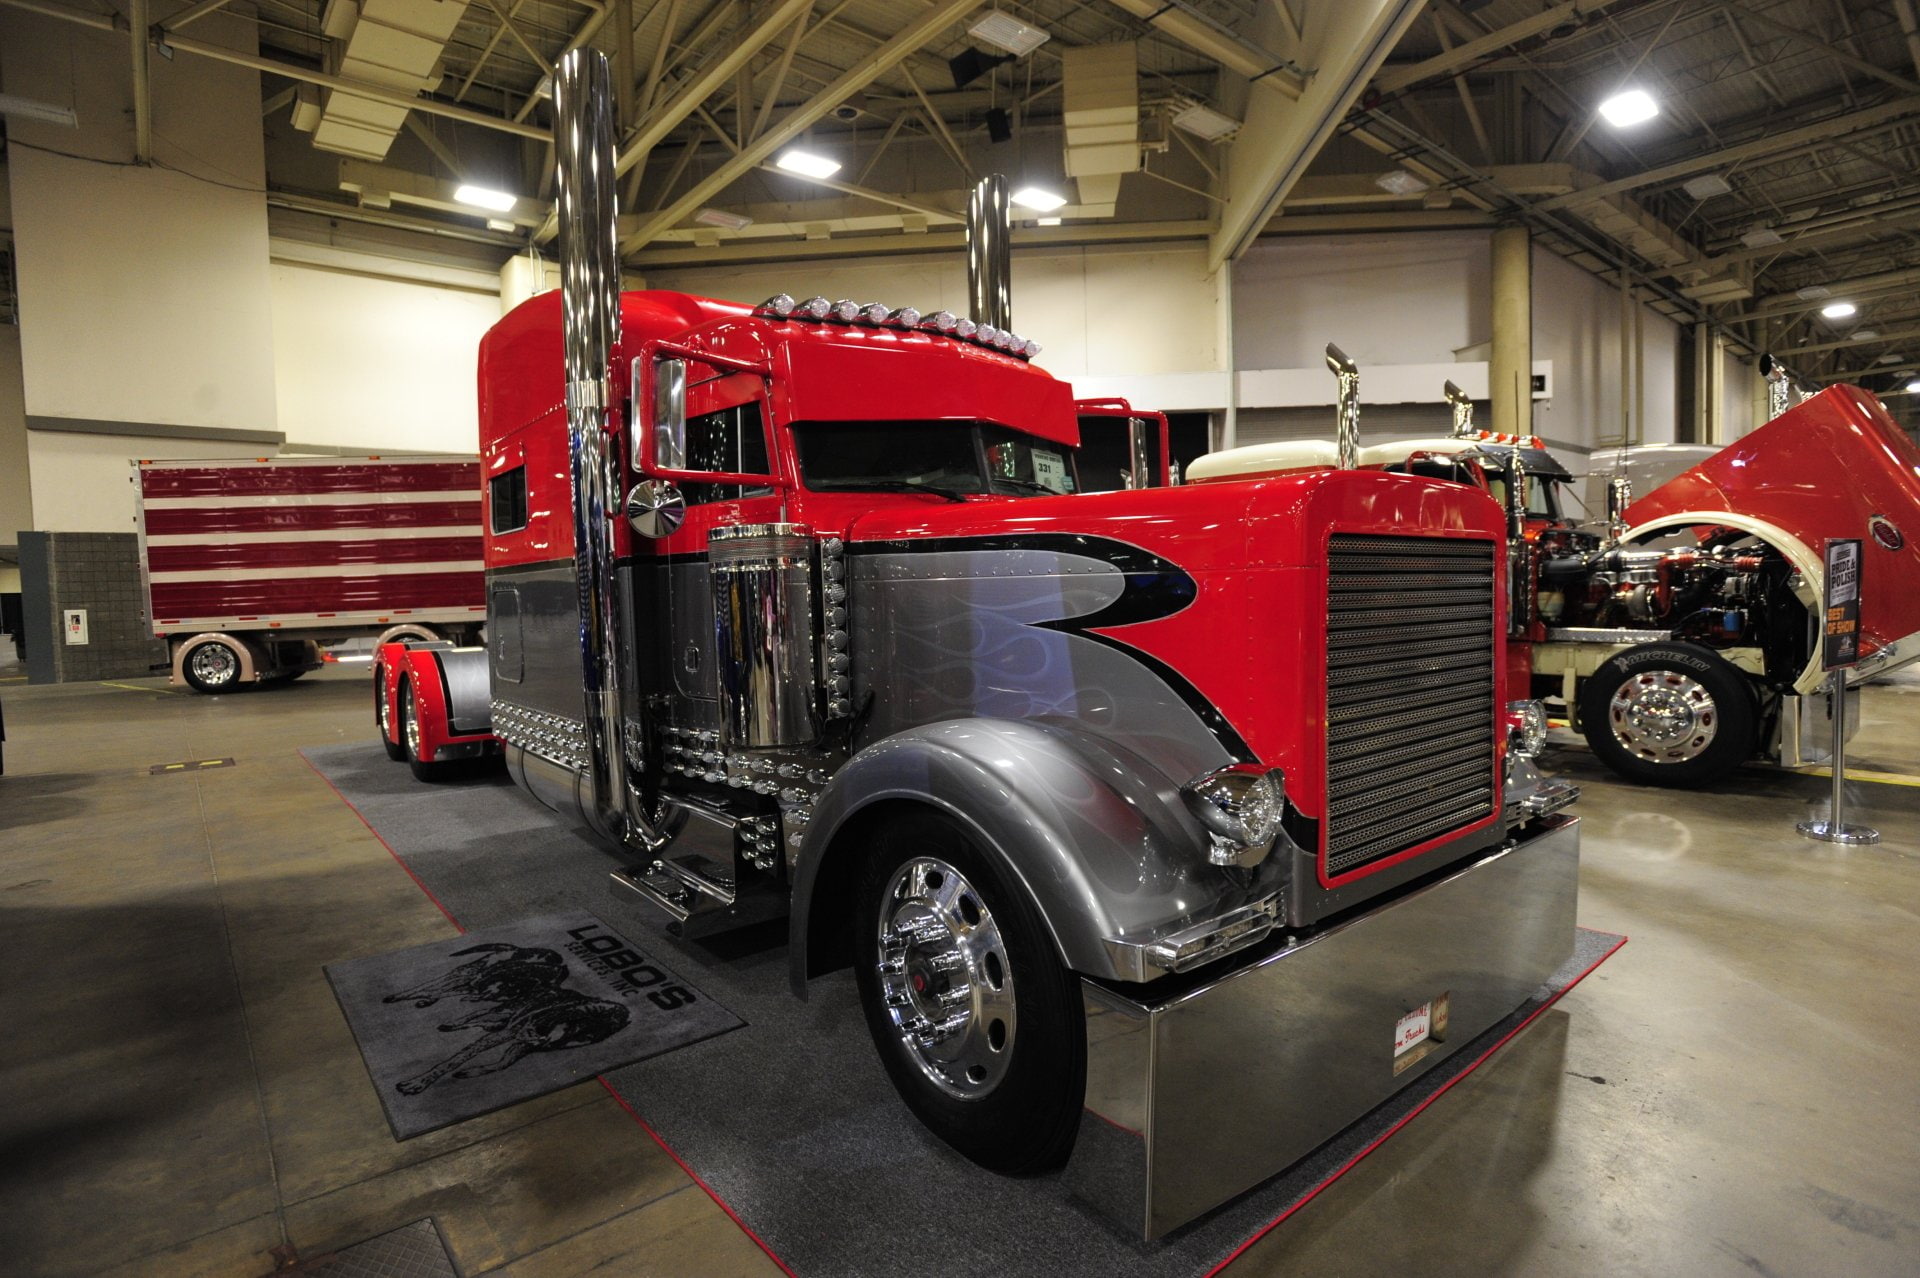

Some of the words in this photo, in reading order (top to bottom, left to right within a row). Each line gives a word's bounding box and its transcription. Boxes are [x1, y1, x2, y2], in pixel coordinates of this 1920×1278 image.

[1038, 462, 1051, 473] 331
[1831, 560, 1850, 576] PRIDE
[1851, 558, 1856, 570] &
[1831, 570, 1856, 589] POLISH
[1828, 608, 1845, 621] BEST
[1828, 622, 1837, 635] OF
[1836, 620, 1856, 634] SHOW
[1627, 650, 1711, 671] MICHELIN
[567, 924, 696, 1010] LOBO'S
